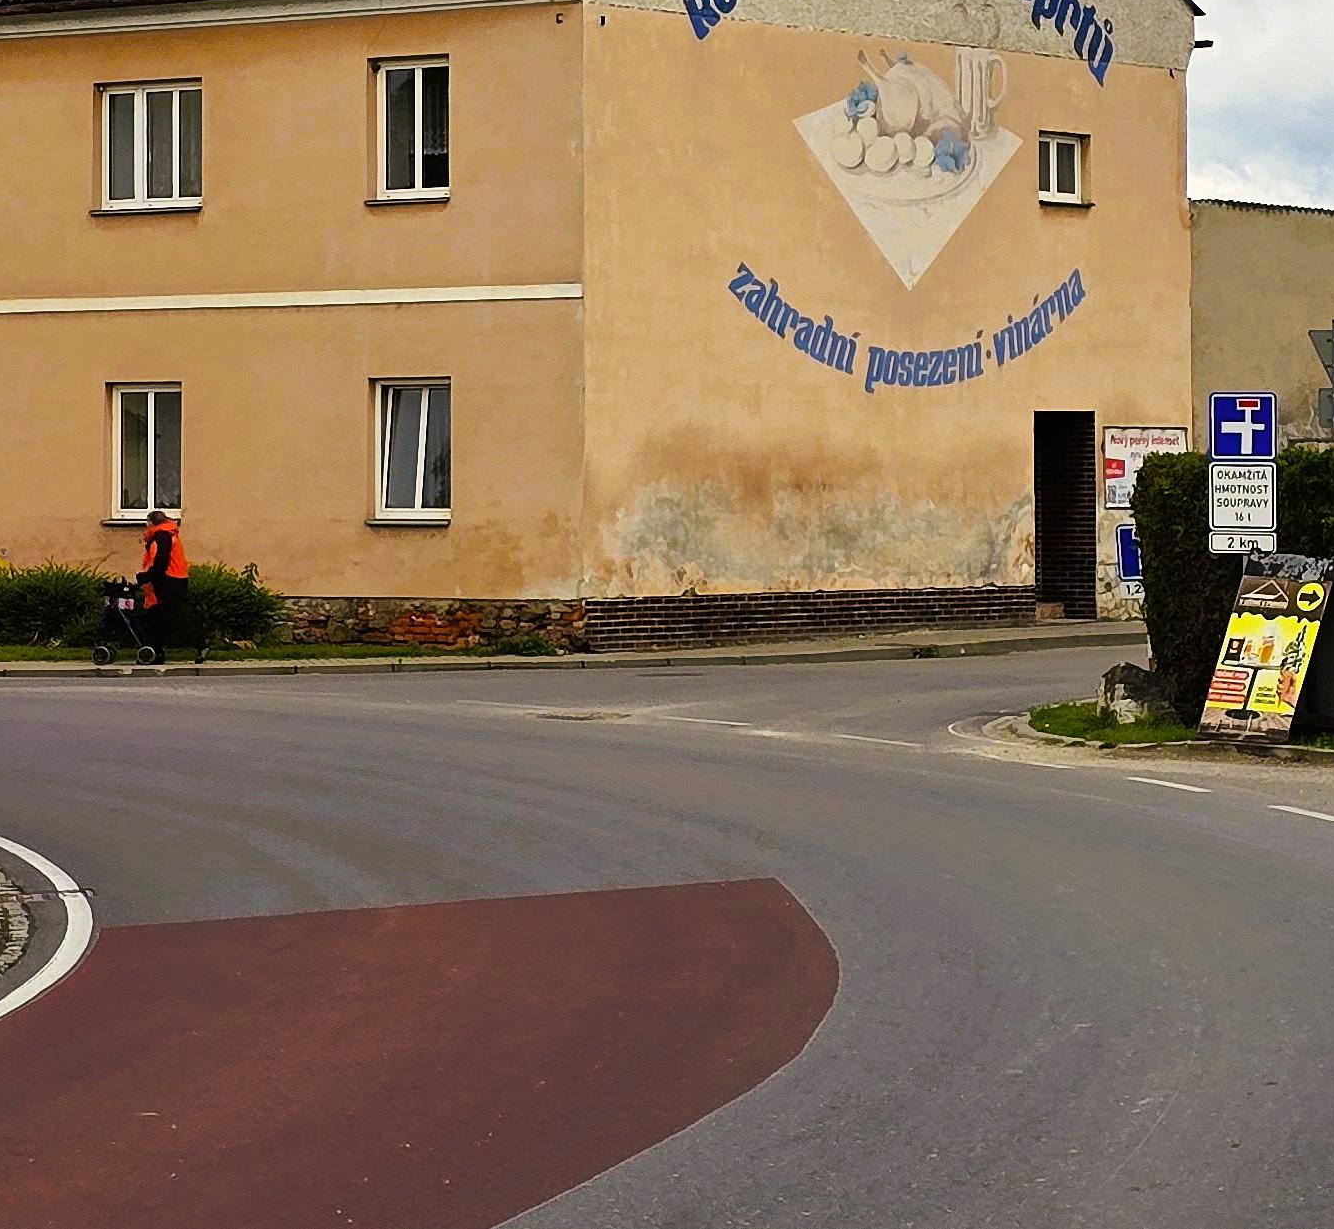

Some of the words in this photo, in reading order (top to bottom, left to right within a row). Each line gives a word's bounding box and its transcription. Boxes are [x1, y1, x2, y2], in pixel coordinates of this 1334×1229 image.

[728, 261, 861, 375] zahradní
[865, 330, 984, 394] posezení
[993, 267, 1086, 367] vinárna
[1217, 469, 1267, 480] OKAMŽITÁ
[1214, 484, 1268, 494] HMOTNOST
[1216, 498, 1269, 508] SOUPRAVY
[1235, 512, 1244, 521] 16
[1227, 537, 1235, 548] 2
[1239, 536, 1259, 549] km
